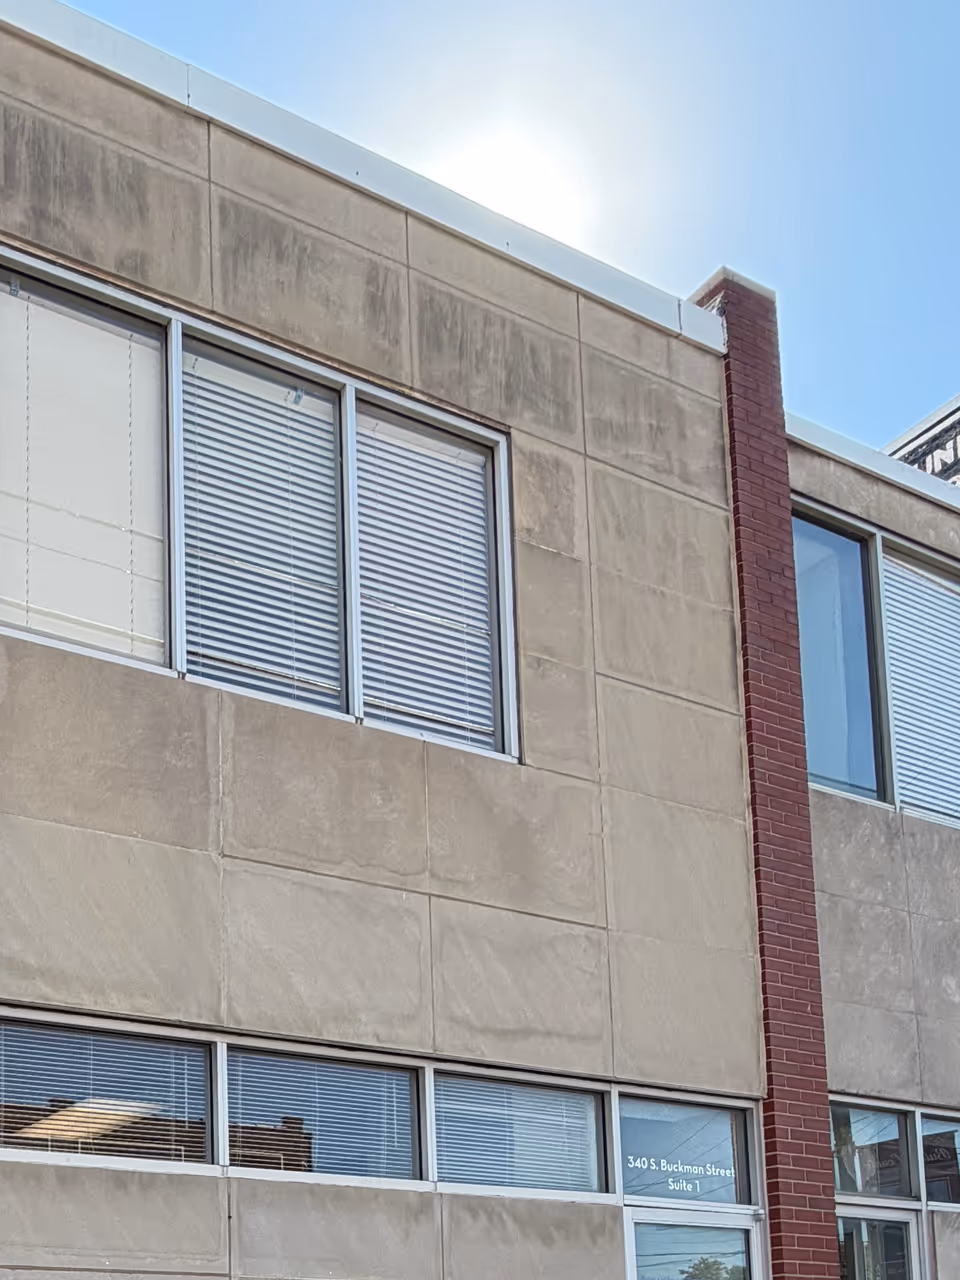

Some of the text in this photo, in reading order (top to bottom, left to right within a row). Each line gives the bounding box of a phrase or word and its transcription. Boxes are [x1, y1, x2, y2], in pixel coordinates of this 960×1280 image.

[627, 1155, 735, 1177] 340 S. Buckman Street
[668, 1177, 700, 1192] Suite 1
